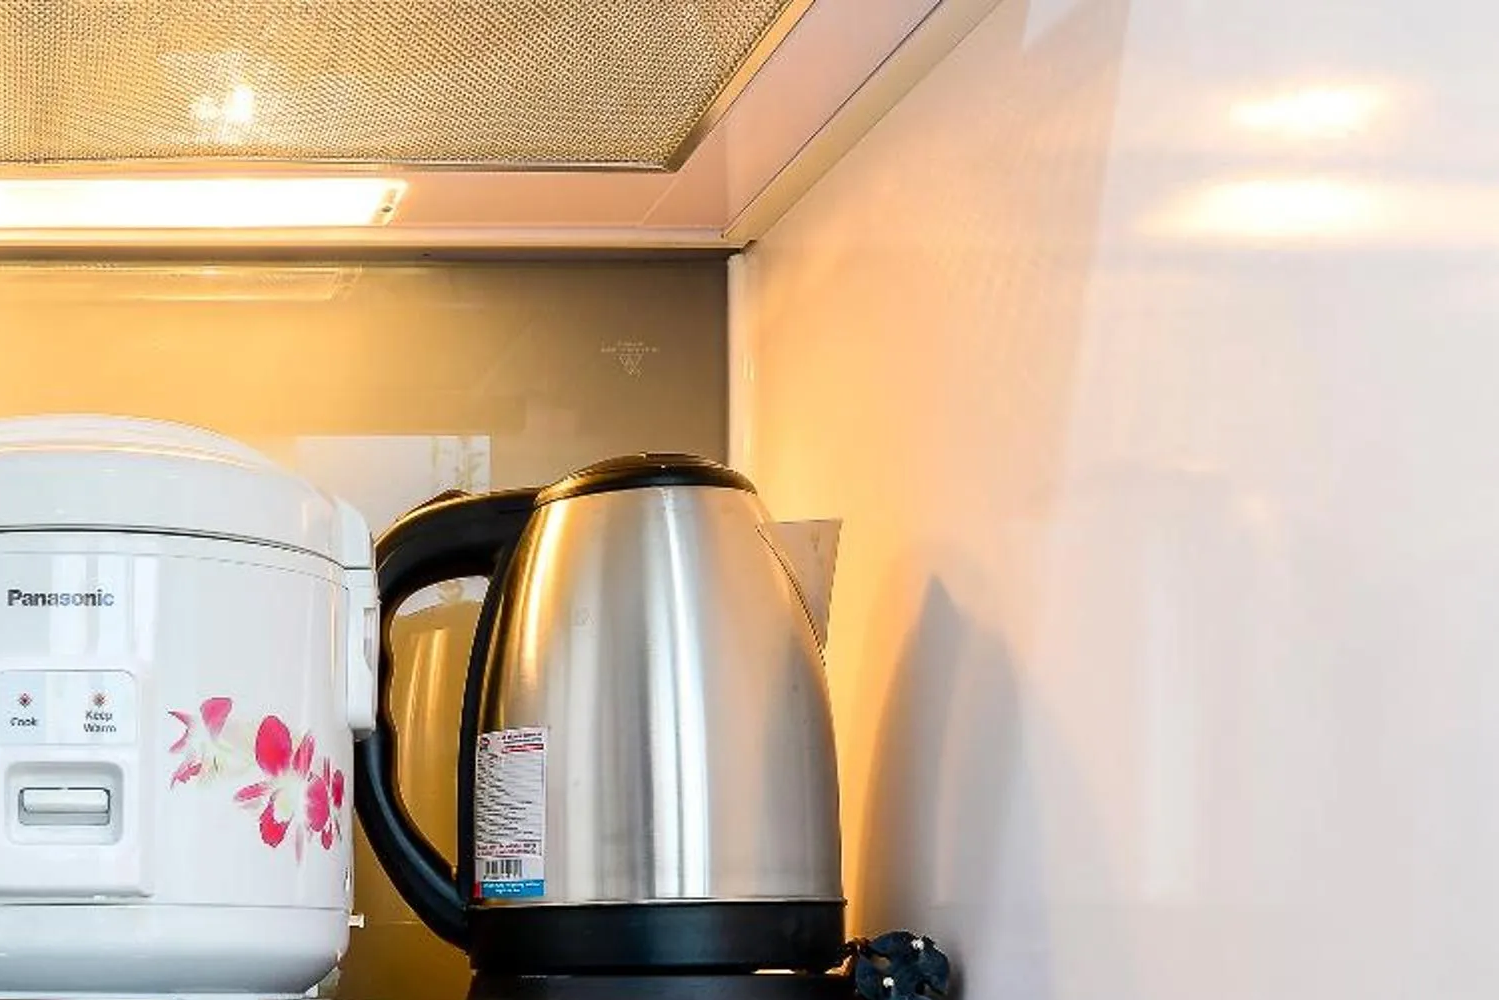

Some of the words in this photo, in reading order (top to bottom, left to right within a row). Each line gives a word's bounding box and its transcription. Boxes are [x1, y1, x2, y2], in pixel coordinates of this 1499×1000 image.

[7, 589, 114, 606] Panasonic
[85, 710, 113, 722] Keep
[10, 717, 38, 727] Cook
[83, 723, 117, 733] Warm
